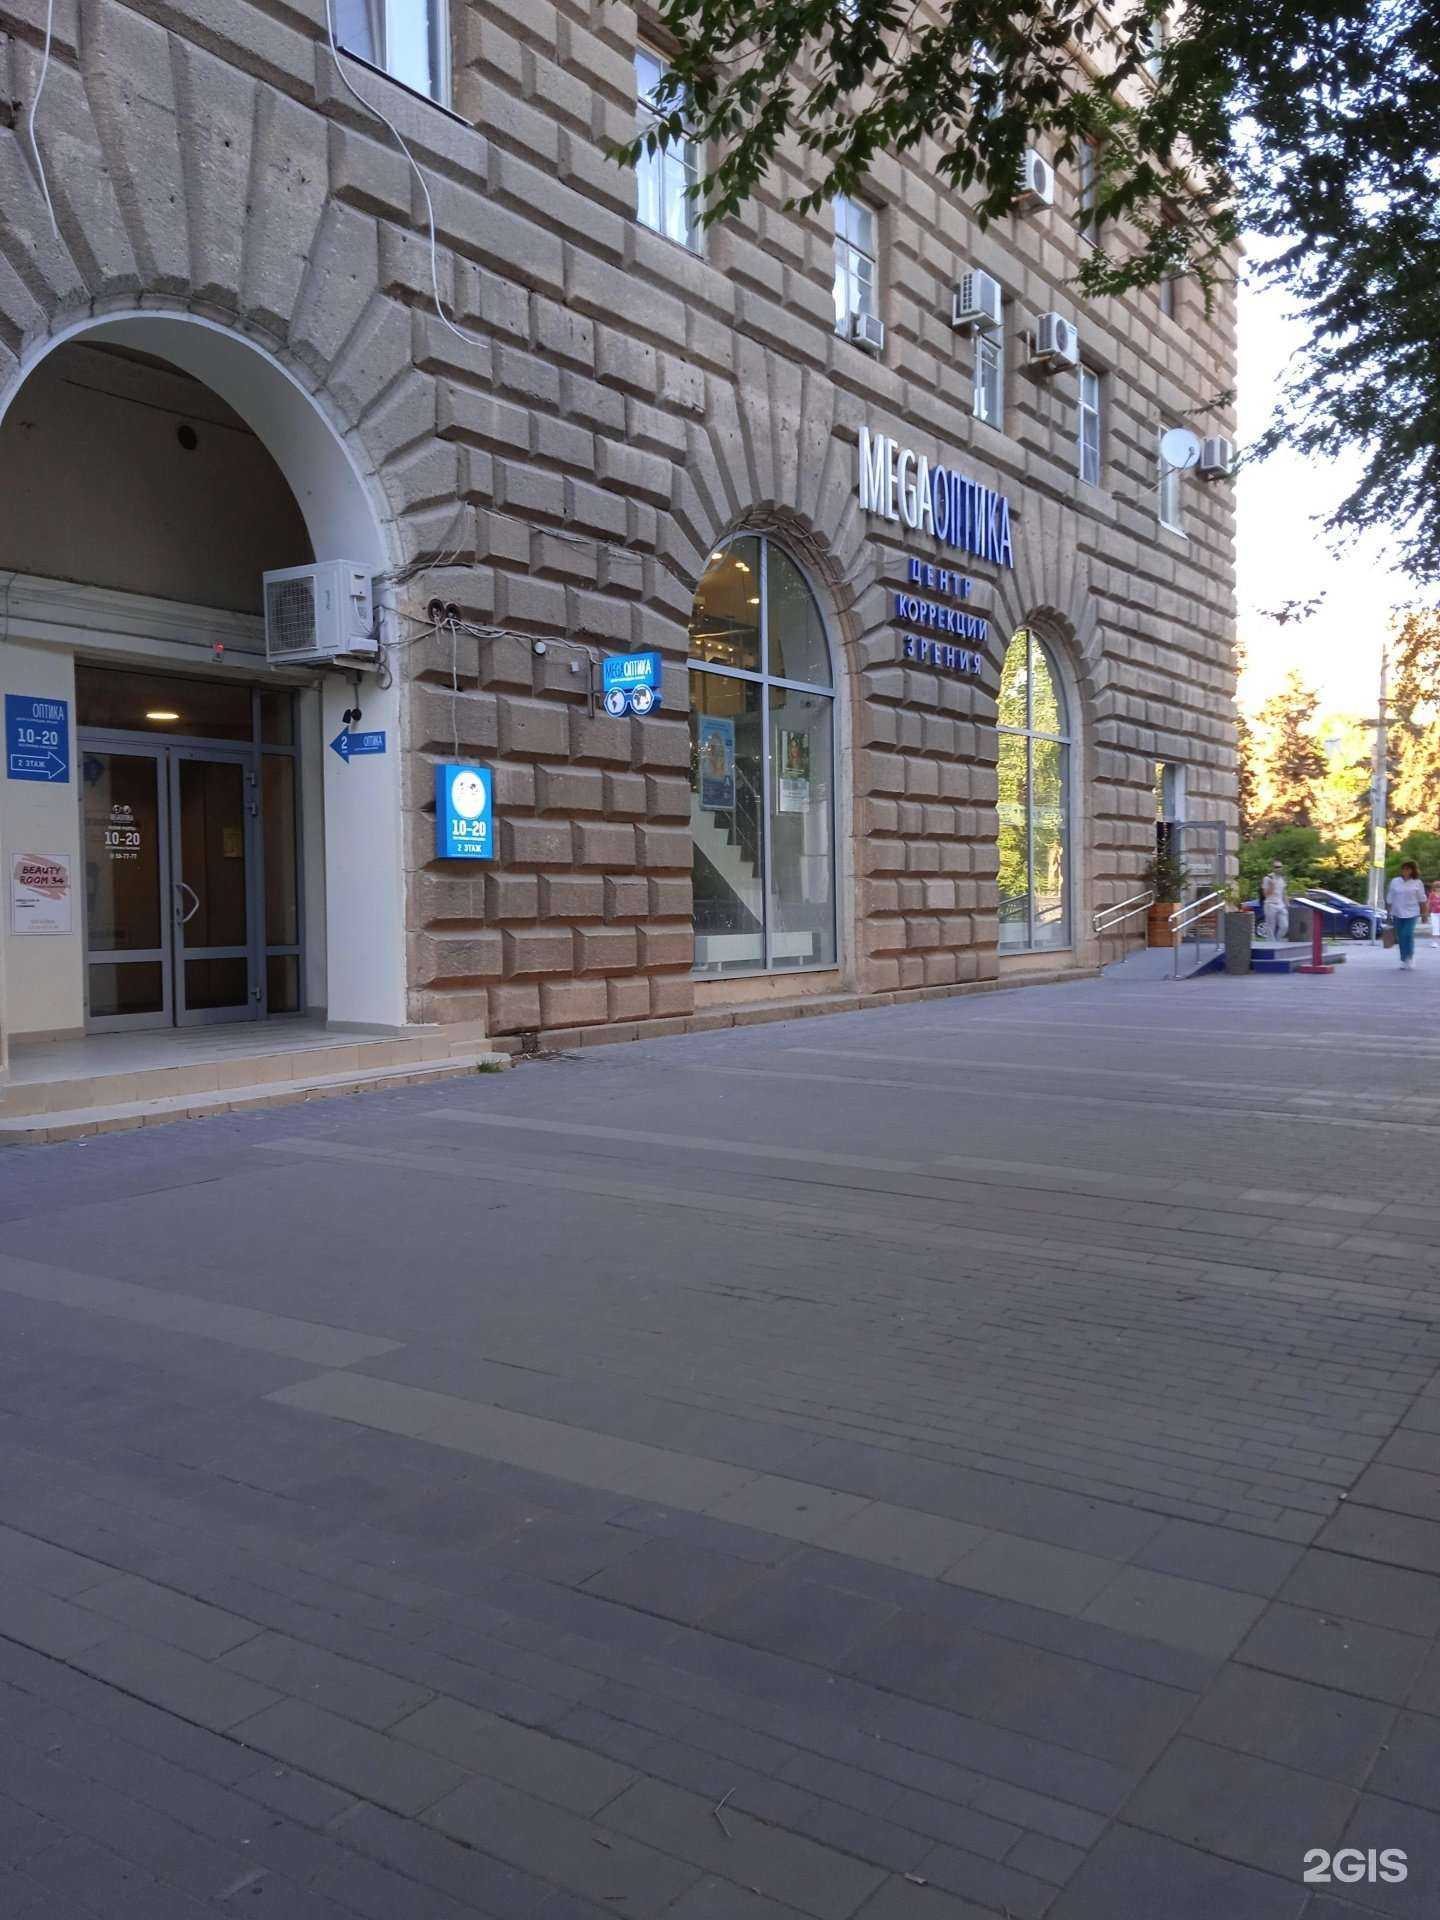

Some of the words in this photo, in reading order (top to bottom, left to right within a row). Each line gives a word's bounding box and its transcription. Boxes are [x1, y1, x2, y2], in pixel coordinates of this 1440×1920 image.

[909, 558, 972, 598] ЦЕНТР
[897, 593, 988, 642] КОРРЕКЦИИ
[904, 635, 982, 676] ЗРЕНИЯ
[32, 703, 65, 721] ОПТИКА
[17, 727, 59, 746] 10-20
[341, 735, 348, 750] 2
[18, 759, 24, 768] 2
[452, 818, 487, 838] 10-20
[104, 831, 141, 846] 10-20
[22, 865, 61, 876] BEAUTY
[19, 875, 48, 886] ROOM
[51, 876, 65, 886] 34
